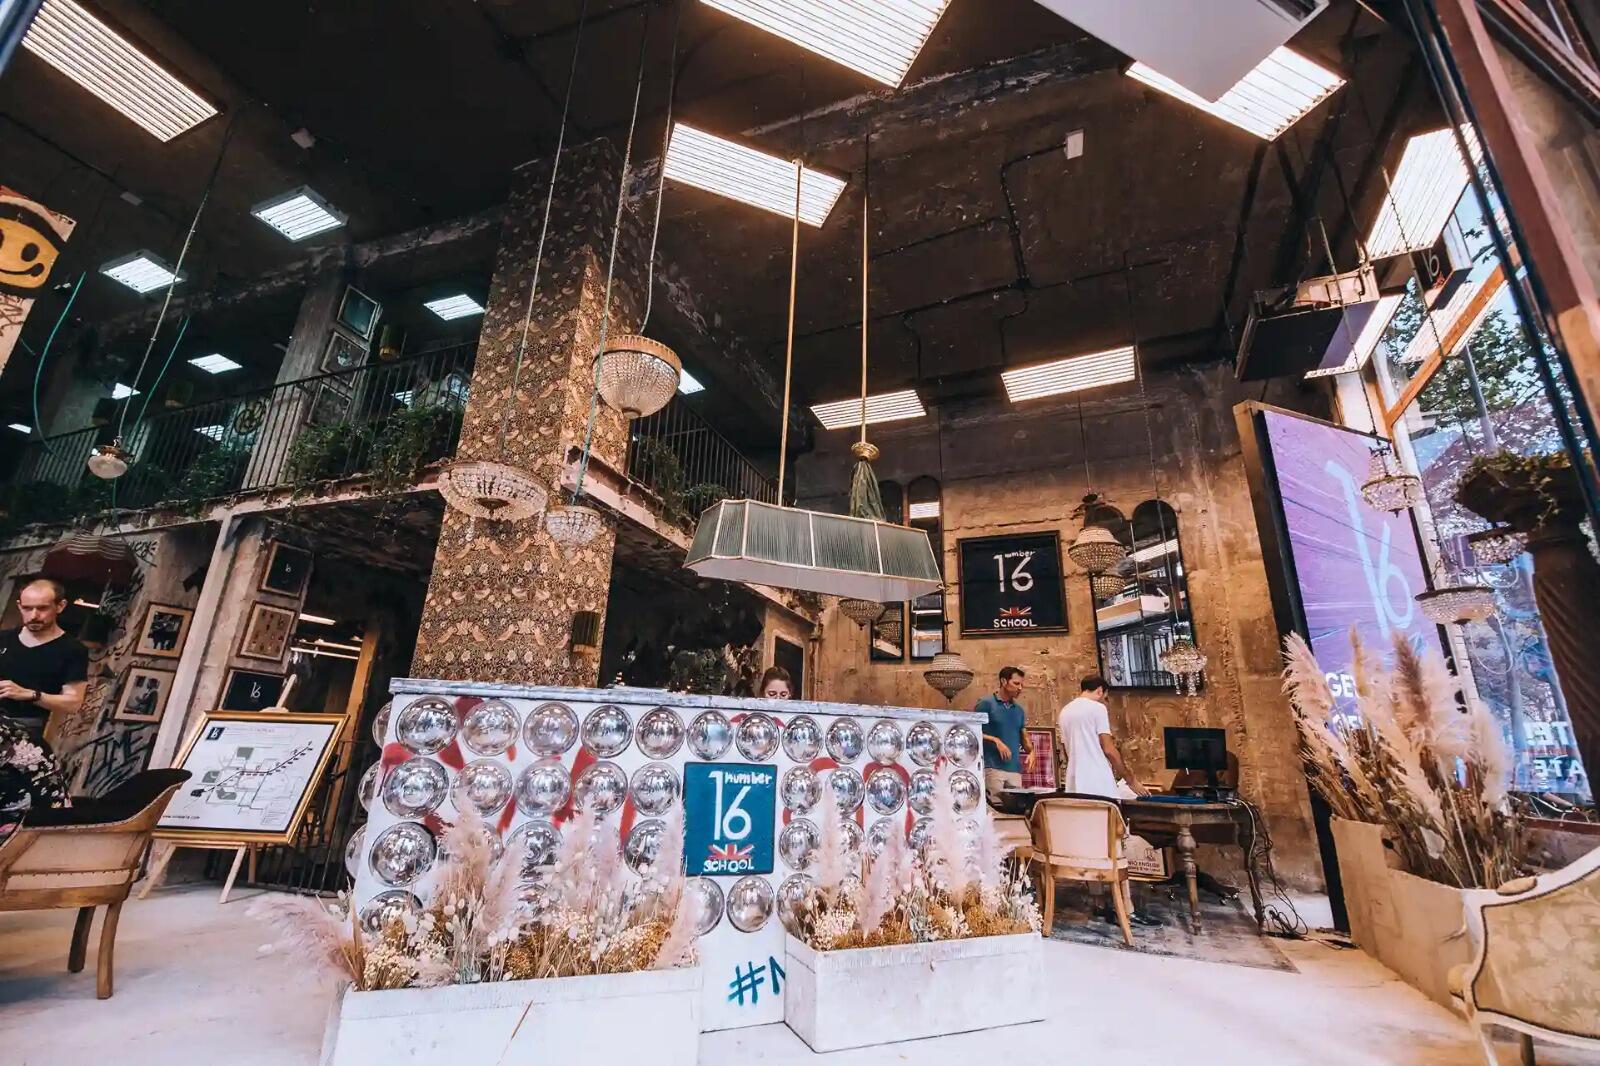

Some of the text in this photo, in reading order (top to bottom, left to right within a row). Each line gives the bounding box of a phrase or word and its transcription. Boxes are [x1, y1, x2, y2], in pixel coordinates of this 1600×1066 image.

[1004, 550, 1036, 558] number
[1323, 460, 1414, 641] 16
[993, 554, 1034, 593] 16
[993, 618, 1038, 628] SCHOOL
[724, 771, 773, 787] number
[708, 771, 752, 841] 16
[703, 858, 755, 873] SCHOOL
